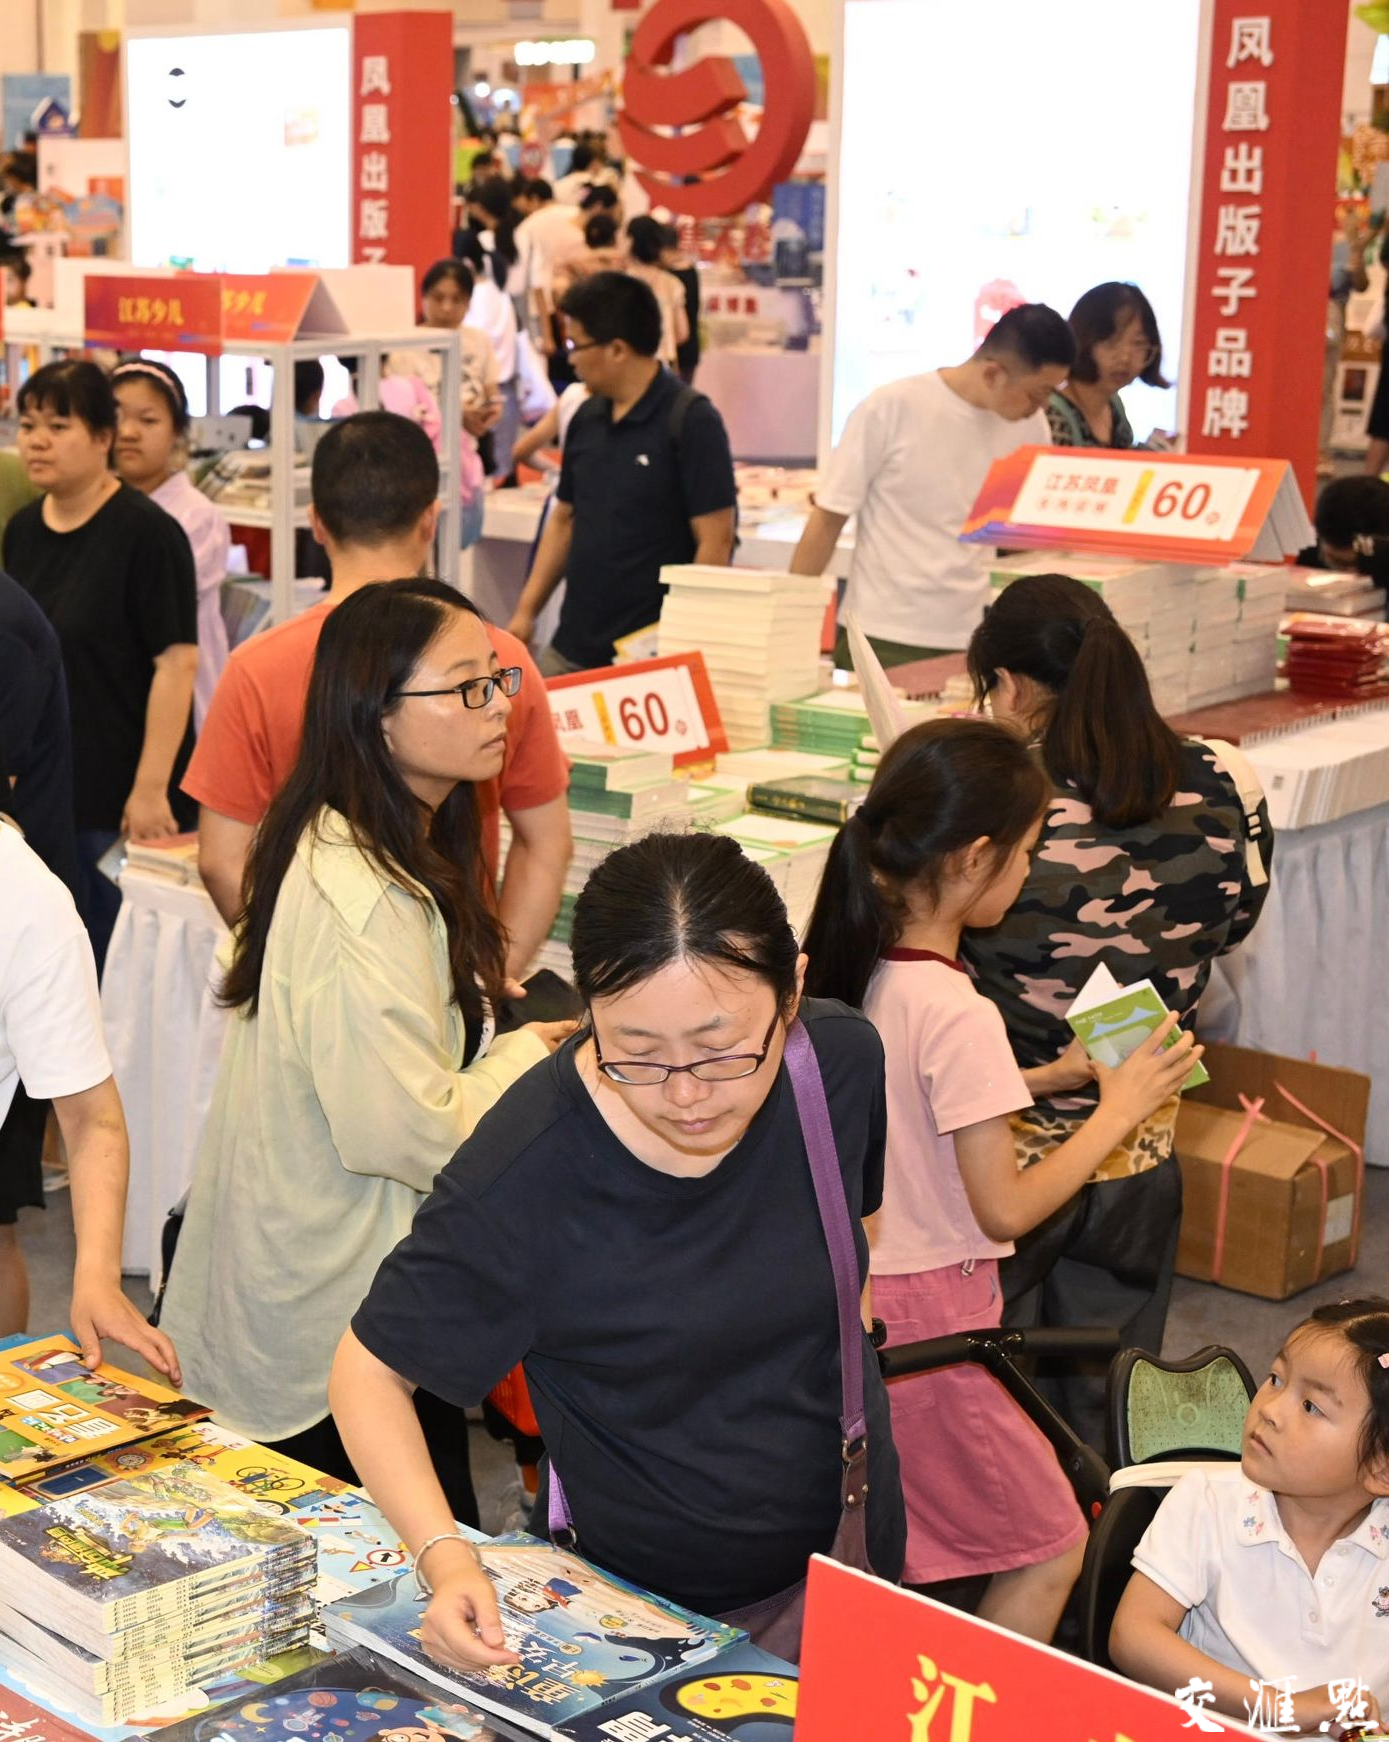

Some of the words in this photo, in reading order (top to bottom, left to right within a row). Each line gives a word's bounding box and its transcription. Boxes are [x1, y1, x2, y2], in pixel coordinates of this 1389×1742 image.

[1202, 16, 1274, 439] 凤凰出版子品牌
[1044, 472, 1119, 496] 江苏凤凰
[1152, 481, 1212, 521] 60
[619, 691, 669, 742] 60
